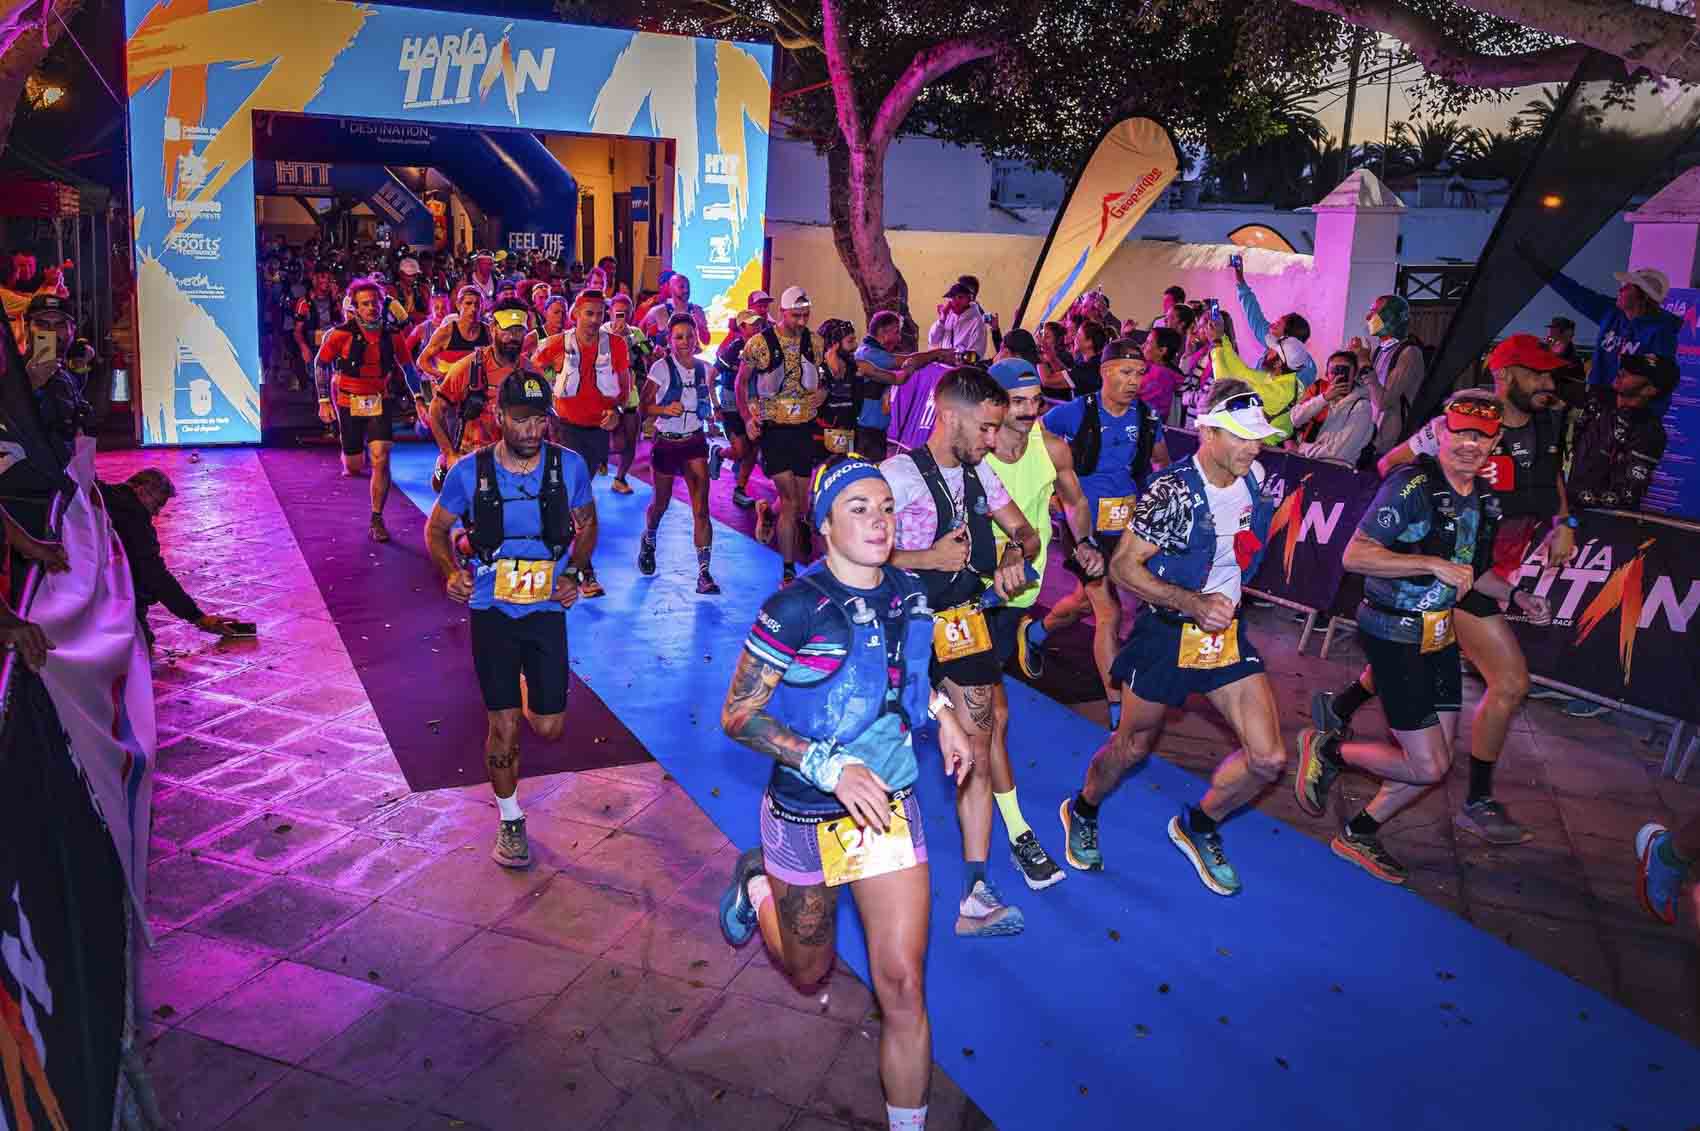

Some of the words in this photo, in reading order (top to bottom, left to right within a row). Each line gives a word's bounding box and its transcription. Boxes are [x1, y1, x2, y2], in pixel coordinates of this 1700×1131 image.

[401, 28, 488, 62] HARÍA
[508, 232, 538, 249] FEEL
[541, 233, 565, 250] THE
[946, 618, 971, 642] 61
